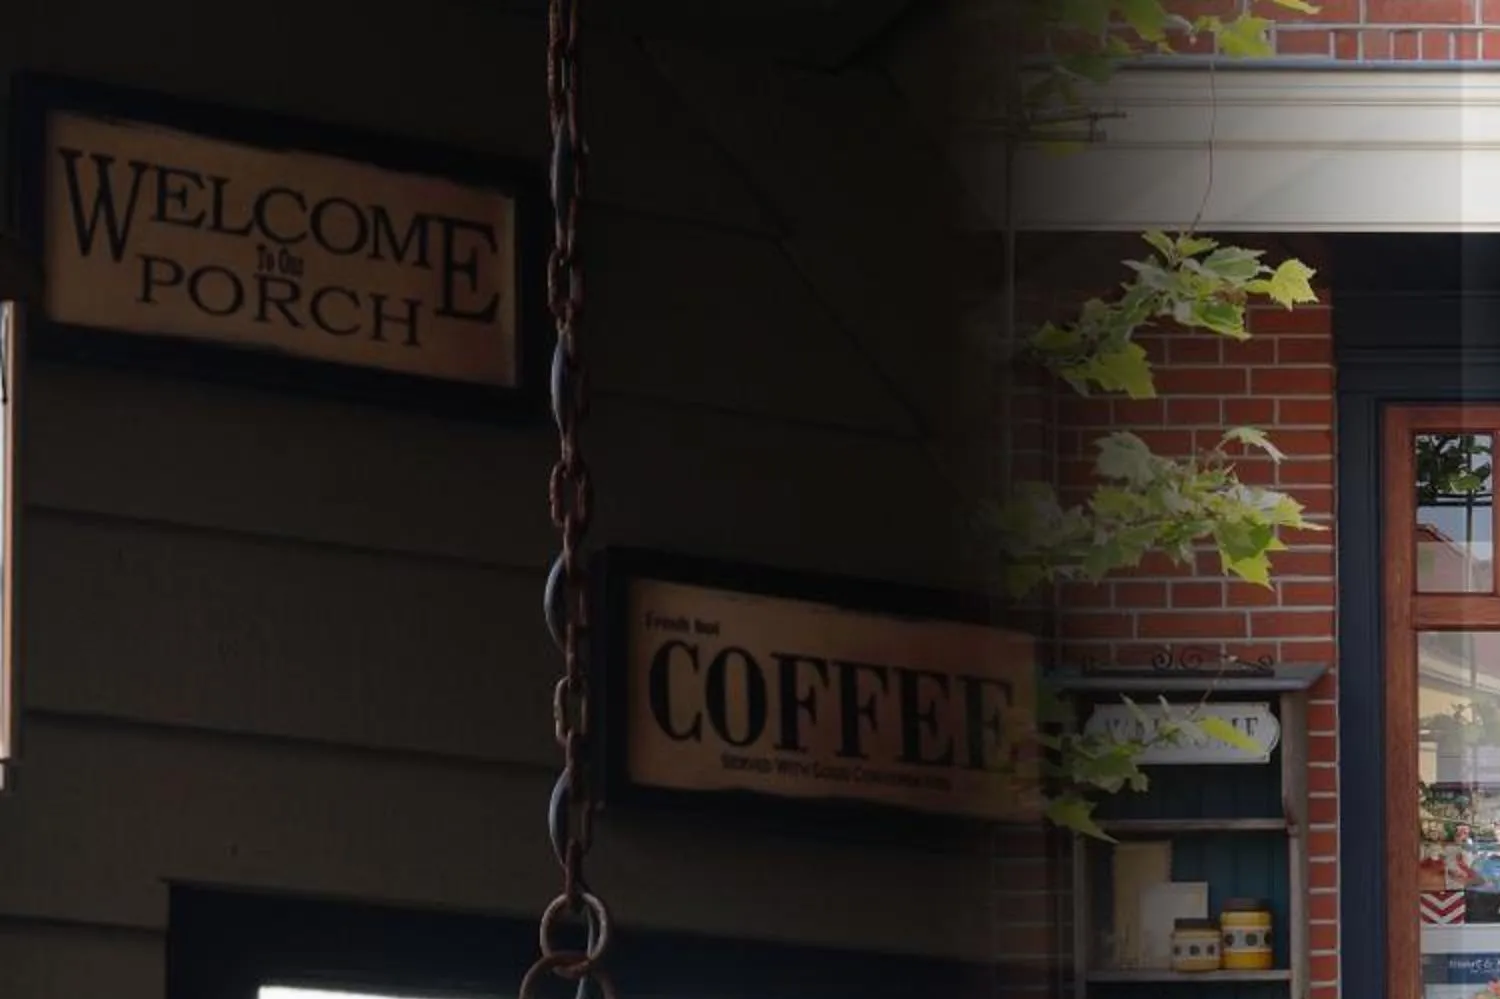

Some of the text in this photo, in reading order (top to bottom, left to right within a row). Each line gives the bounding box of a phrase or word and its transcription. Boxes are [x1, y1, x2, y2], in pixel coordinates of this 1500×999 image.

[58, 148, 498, 323] WELCOME
[136, 254, 422, 346] PORCH
[649, 639, 1016, 774] COFFEE
